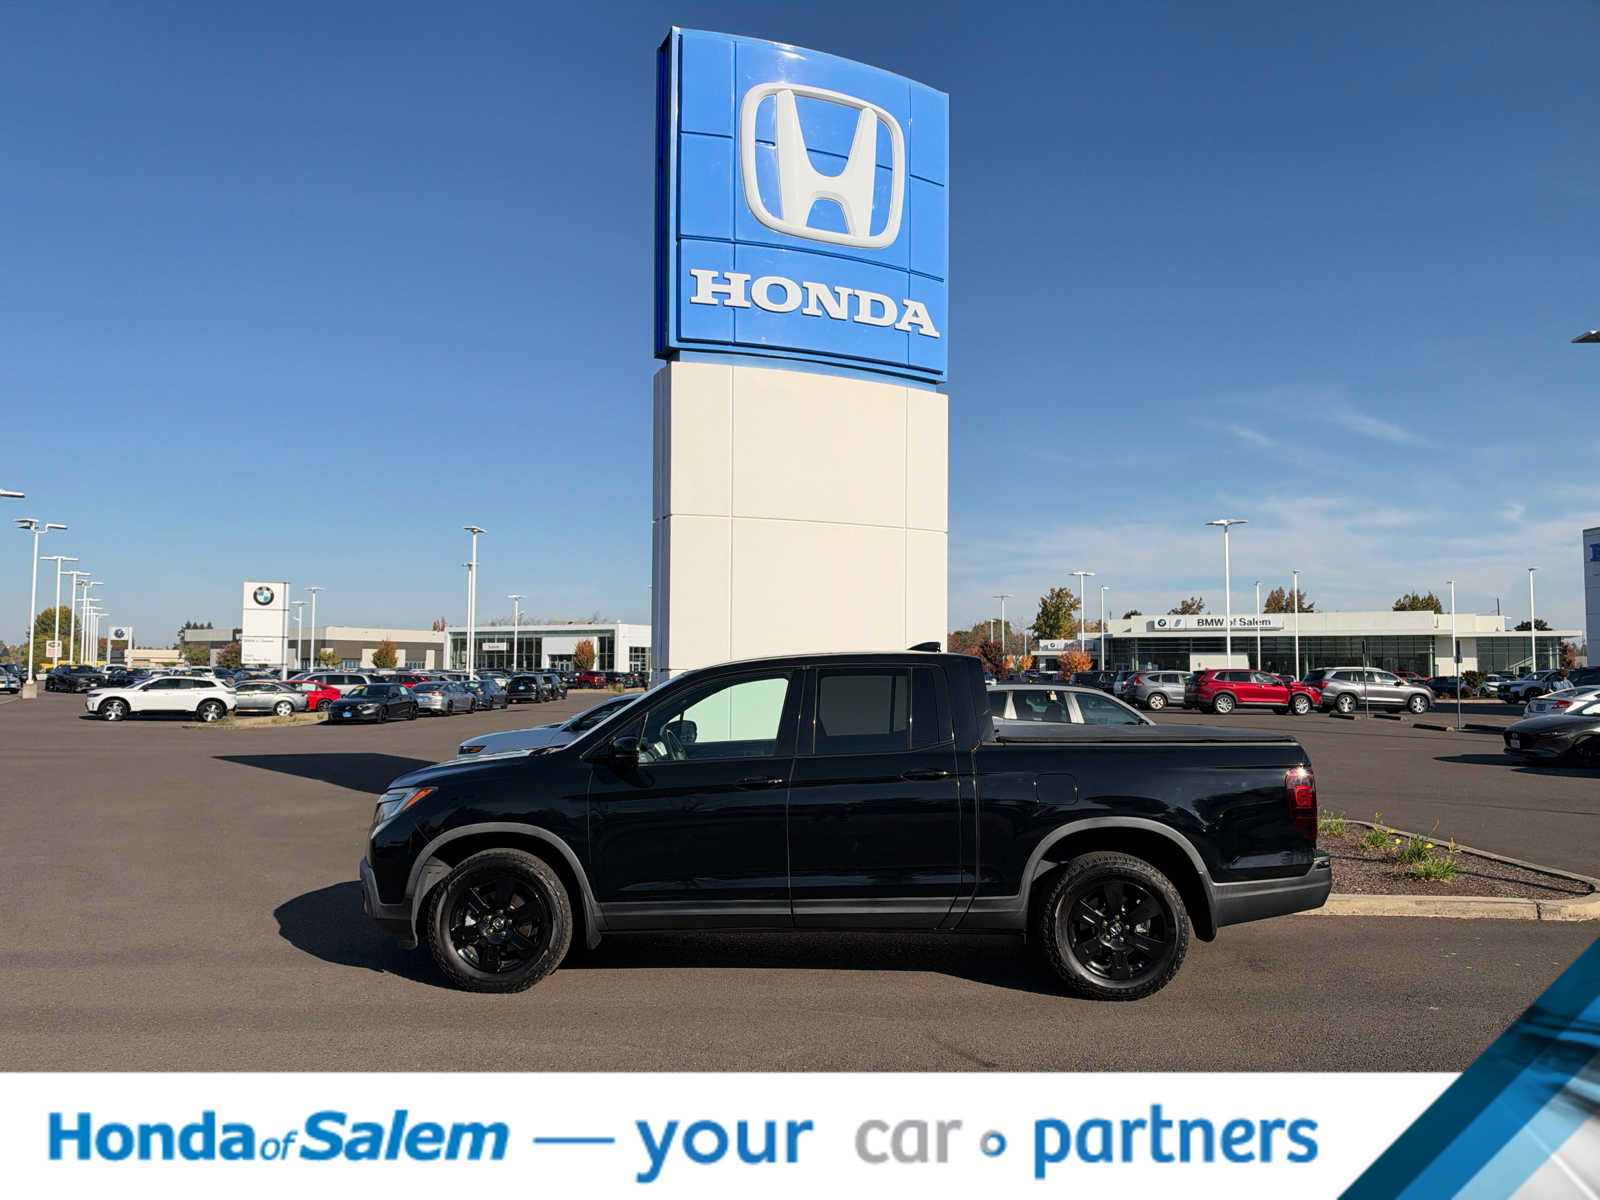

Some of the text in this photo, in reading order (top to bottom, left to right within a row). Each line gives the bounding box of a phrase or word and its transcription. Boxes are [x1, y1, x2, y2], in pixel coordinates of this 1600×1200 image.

[689, 268, 941, 339] HONDA
[1196, 618, 1224, 627] BMW
[1239, 617, 1271, 626] Salem
